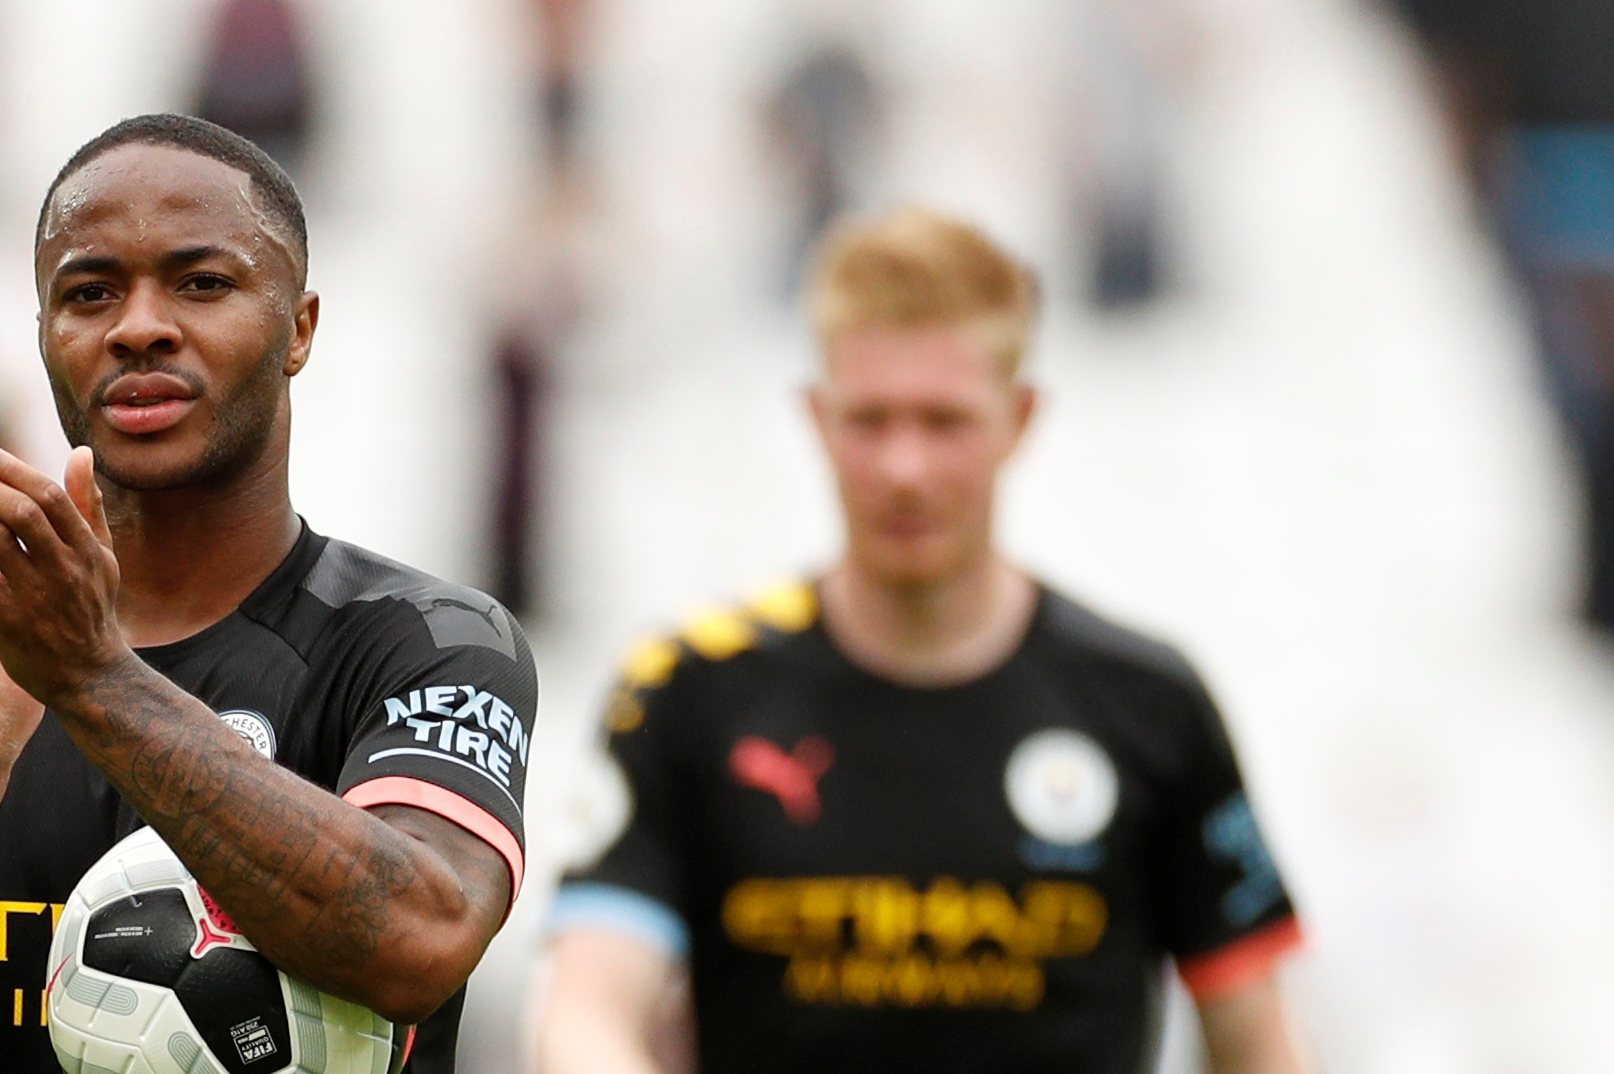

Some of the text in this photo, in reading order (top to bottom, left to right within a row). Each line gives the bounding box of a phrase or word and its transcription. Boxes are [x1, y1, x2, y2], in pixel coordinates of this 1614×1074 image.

[384, 685, 528, 767] NEXEN
[406, 717, 512, 787] TIRE
[243, 1042, 274, 1060] FIFA
